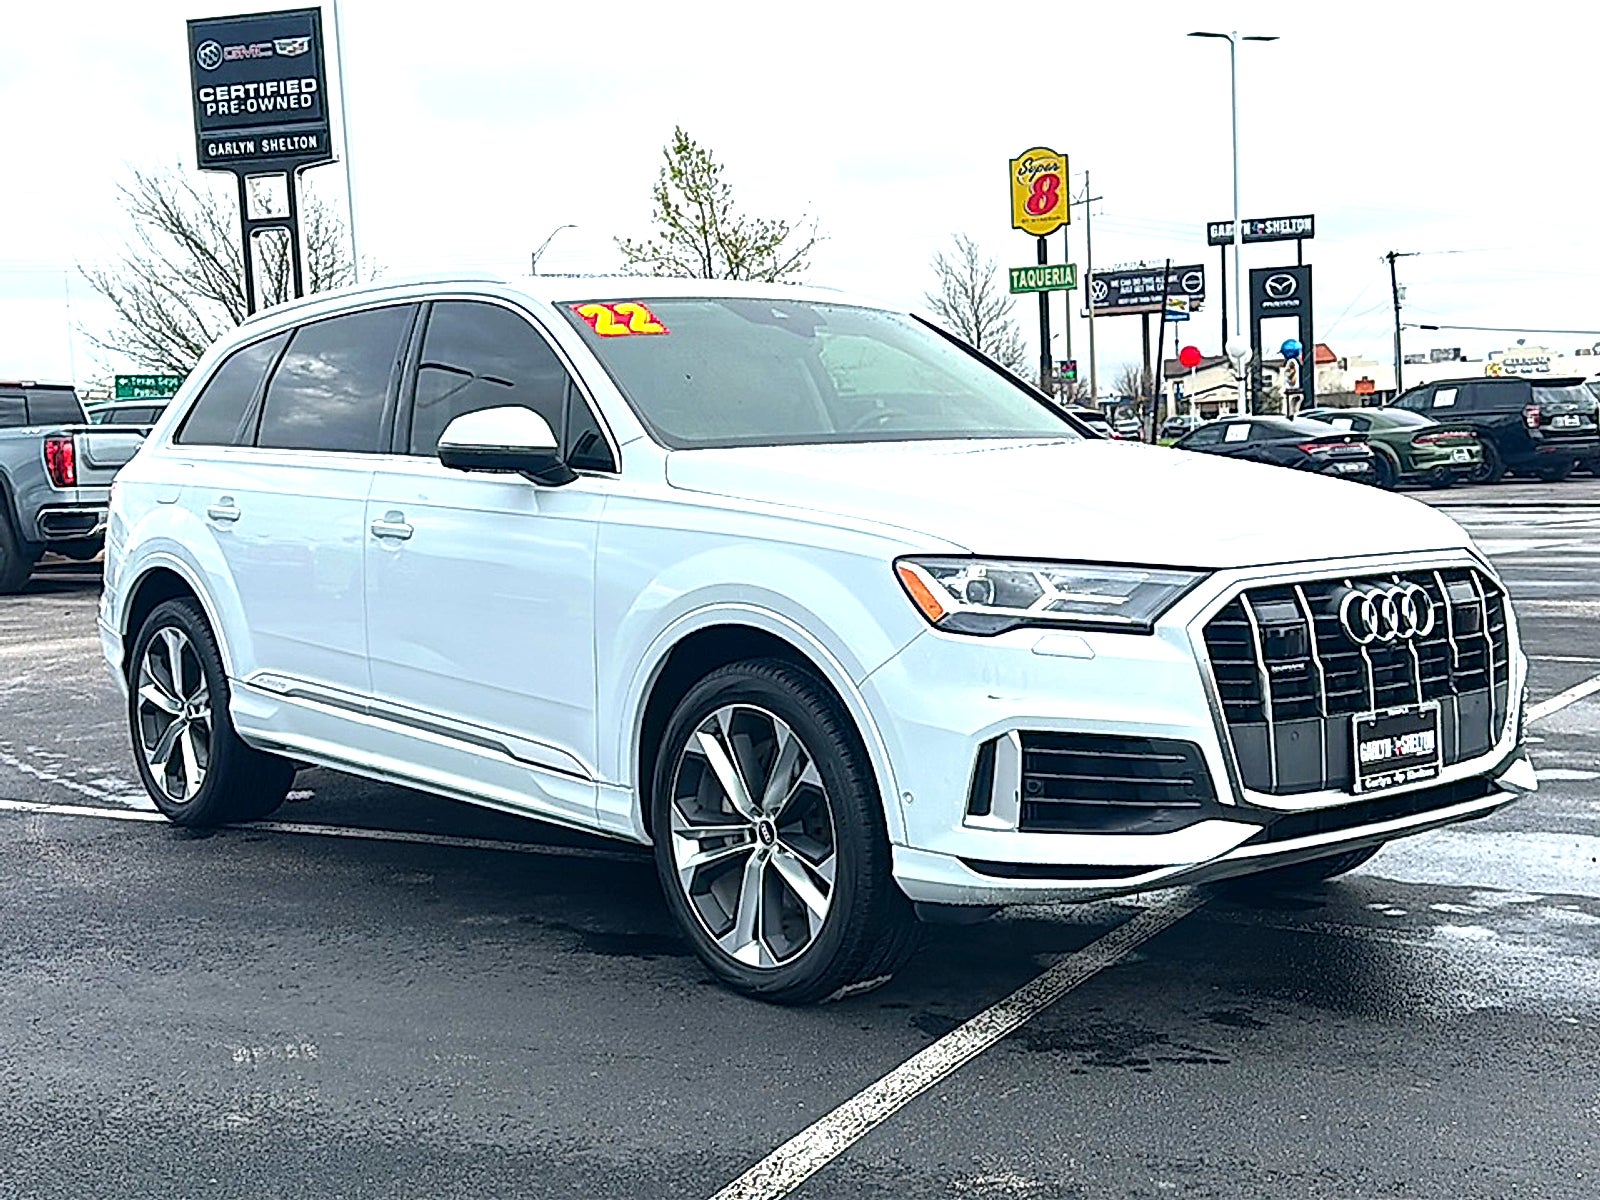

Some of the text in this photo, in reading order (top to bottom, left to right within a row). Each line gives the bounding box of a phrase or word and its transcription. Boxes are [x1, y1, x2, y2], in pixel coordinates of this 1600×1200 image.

[200, 78, 317, 102] CERTIFIED
[206, 94, 312, 116] PRE-OWNED
[208, 135, 318, 156] GARLYN SHELTON
[1018, 157, 1060, 182] Super
[1026, 173, 1061, 215] 8
[1210, 217, 1312, 238] GARN SHELTON
[1011, 266, 1073, 288] TAQUERIA
[577, 302, 664, 336] 22
